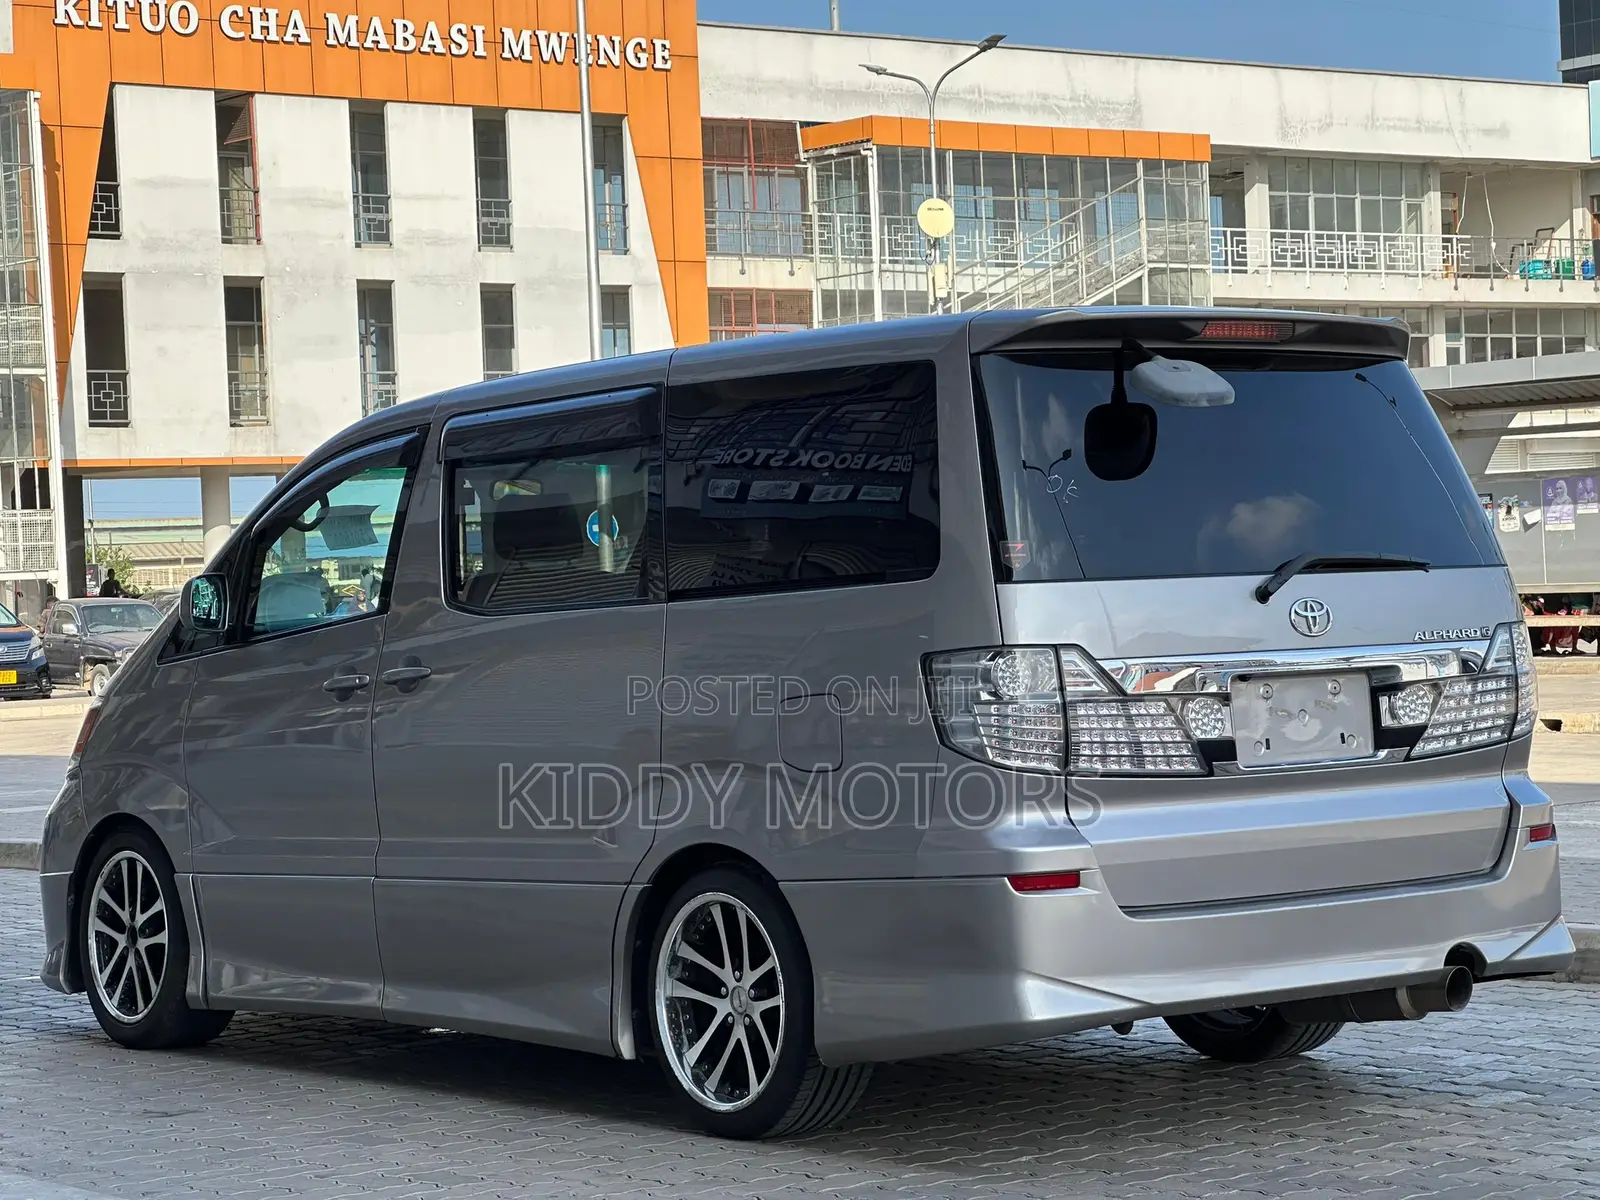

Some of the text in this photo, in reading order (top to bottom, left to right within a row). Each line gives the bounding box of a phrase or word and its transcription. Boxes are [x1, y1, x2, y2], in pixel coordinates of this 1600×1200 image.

[53, 0, 672, 71] KITUO CHA MABASI MWENGE
[1413, 628, 1480, 642] ALPHARD
